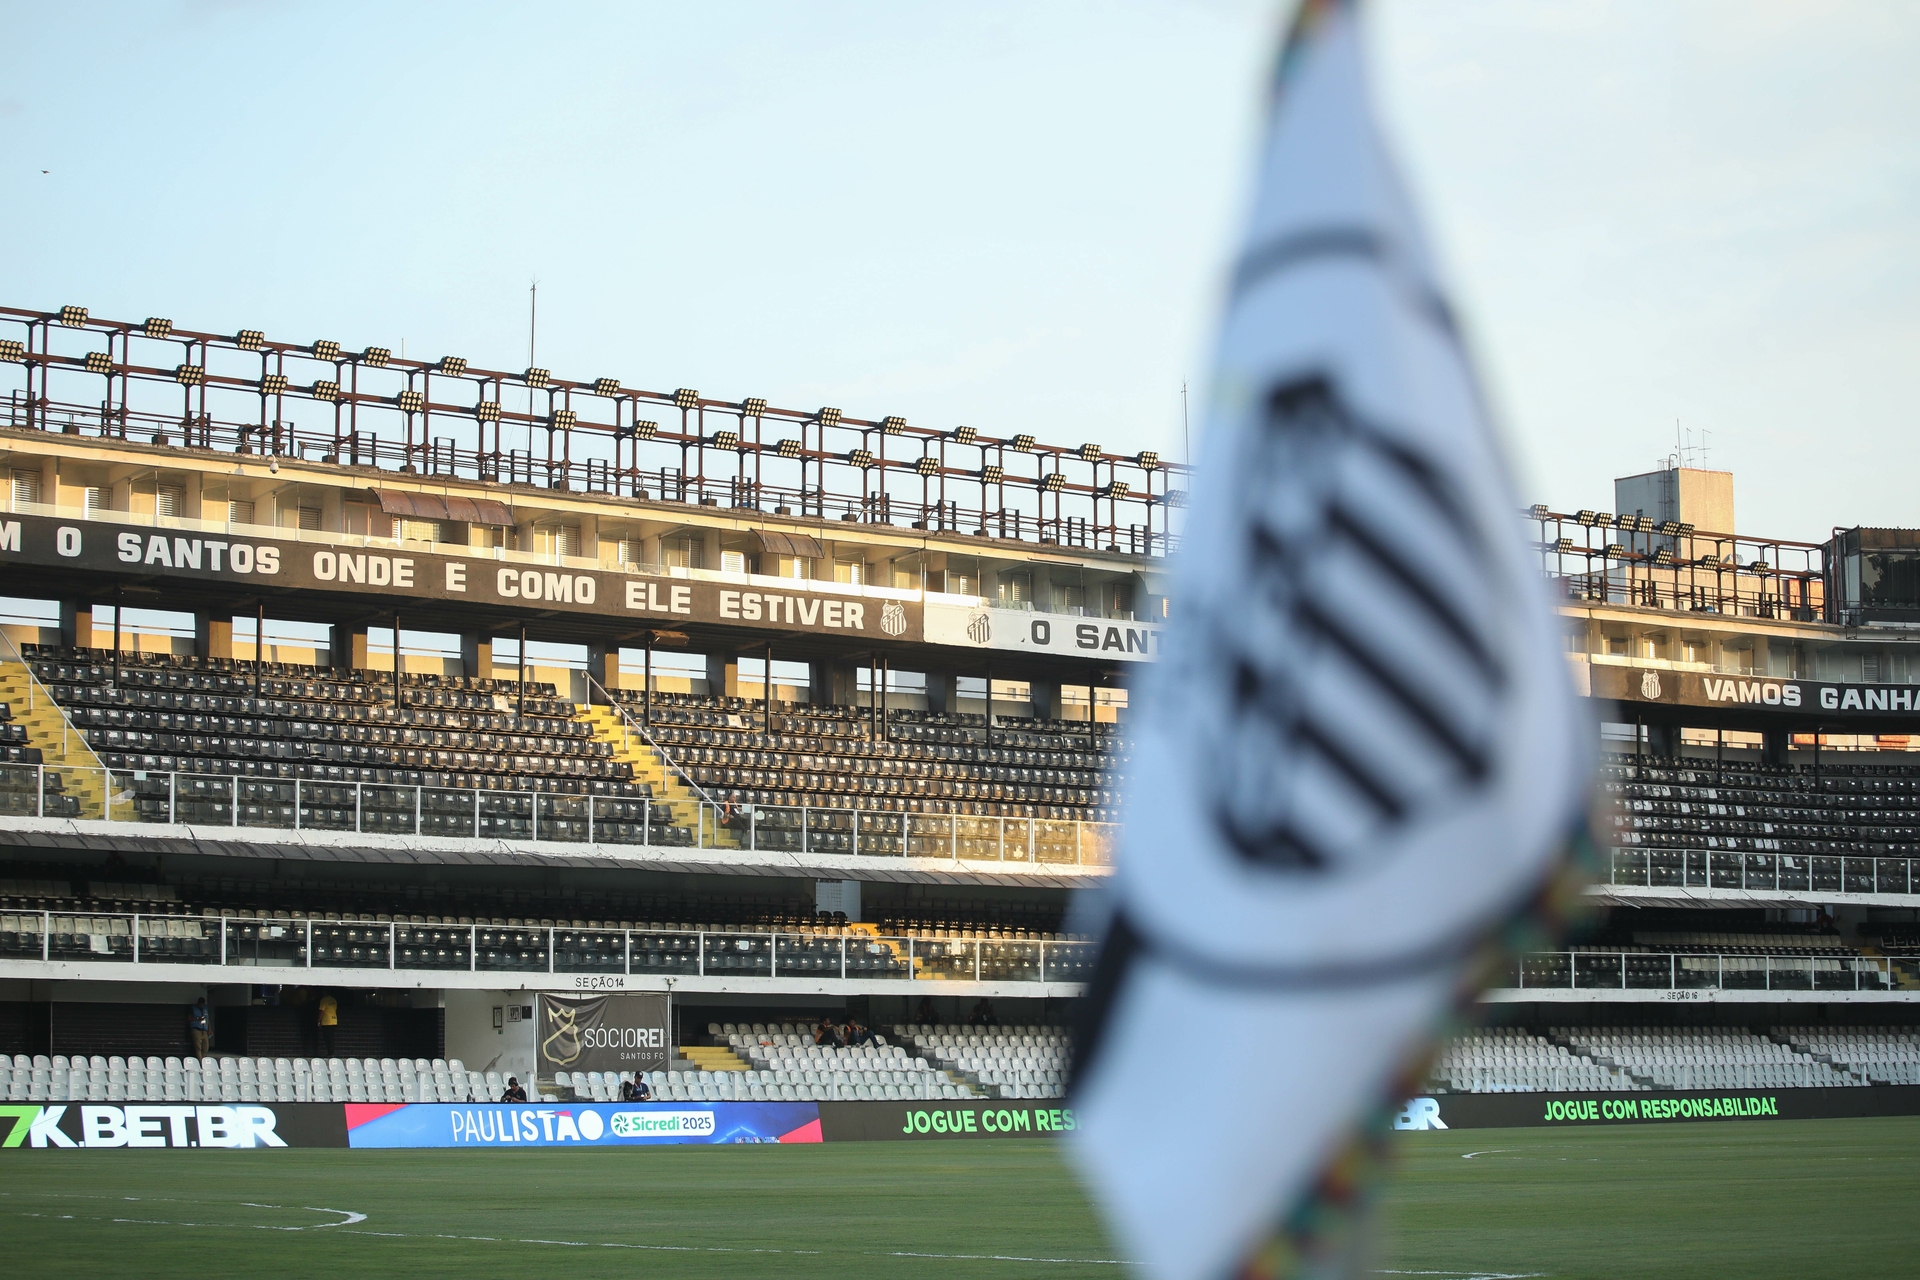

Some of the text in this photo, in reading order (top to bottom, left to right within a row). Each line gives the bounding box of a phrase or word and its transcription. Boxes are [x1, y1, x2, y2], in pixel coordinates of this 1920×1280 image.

[57, 526, 82, 557] O
[118, 532, 280, 575] SANTOS
[313, 552, 414, 588] ONDE
[446, 562, 467, 593] E
[497, 568, 596, 605] COMO
[625, 581, 691, 615] ELE
[719, 589, 865, 630] ESTIVER
[1030, 620, 1051, 645] O
[1703, 677, 1802, 708] VAMOS
[584, 1022, 664, 1048] SÓCIOREI
[620, 1052, 664, 1060] SANTOS FC
[902, 1110, 978, 1133] JOGUE
[981, 1109, 1031, 1132] COM
[1544, 1100, 1600, 1121] JOGUE
[1602, 1098, 1638, 1120] COM
[632, 1116, 712, 1131] Sicredi 2025
